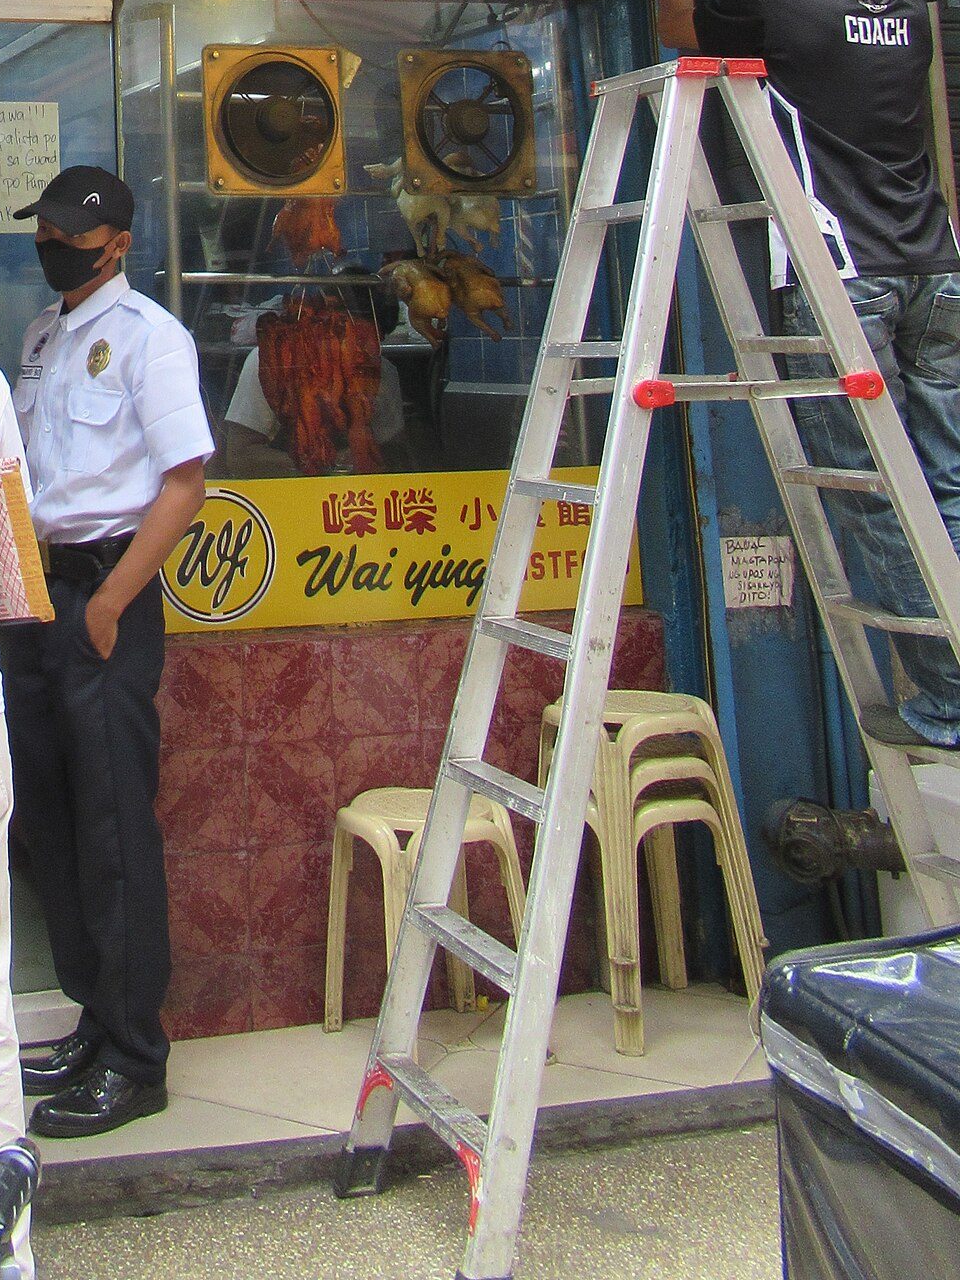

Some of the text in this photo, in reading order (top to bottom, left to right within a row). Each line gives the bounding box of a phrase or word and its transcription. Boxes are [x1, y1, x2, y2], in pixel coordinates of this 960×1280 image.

[844, 14, 910, 46] COACH
[43, 133, 57, 151] po
[296, 543, 398, 598] Wai
